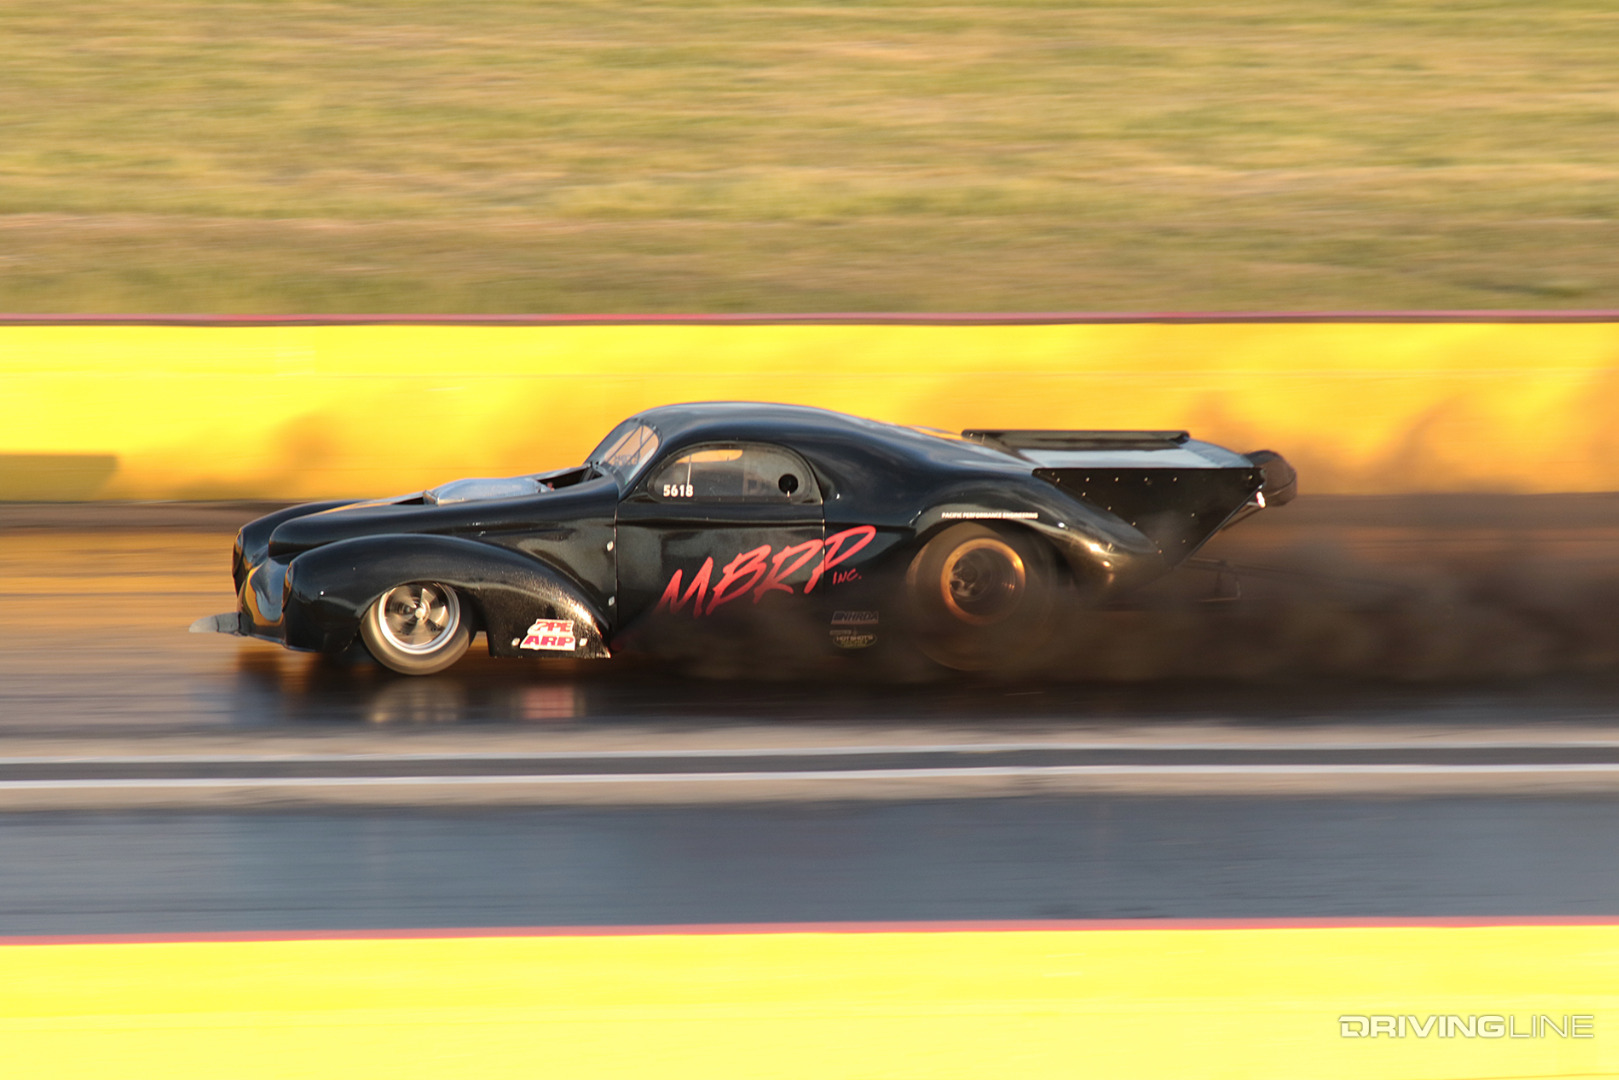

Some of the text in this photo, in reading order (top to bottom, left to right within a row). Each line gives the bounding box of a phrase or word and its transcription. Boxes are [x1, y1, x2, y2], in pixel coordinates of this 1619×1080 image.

[663, 484, 694, 498] 5618
[652, 525, 877, 619] MBRP
[832, 568, 863, 586] INC.
[523, 635, 575, 647] ARP
